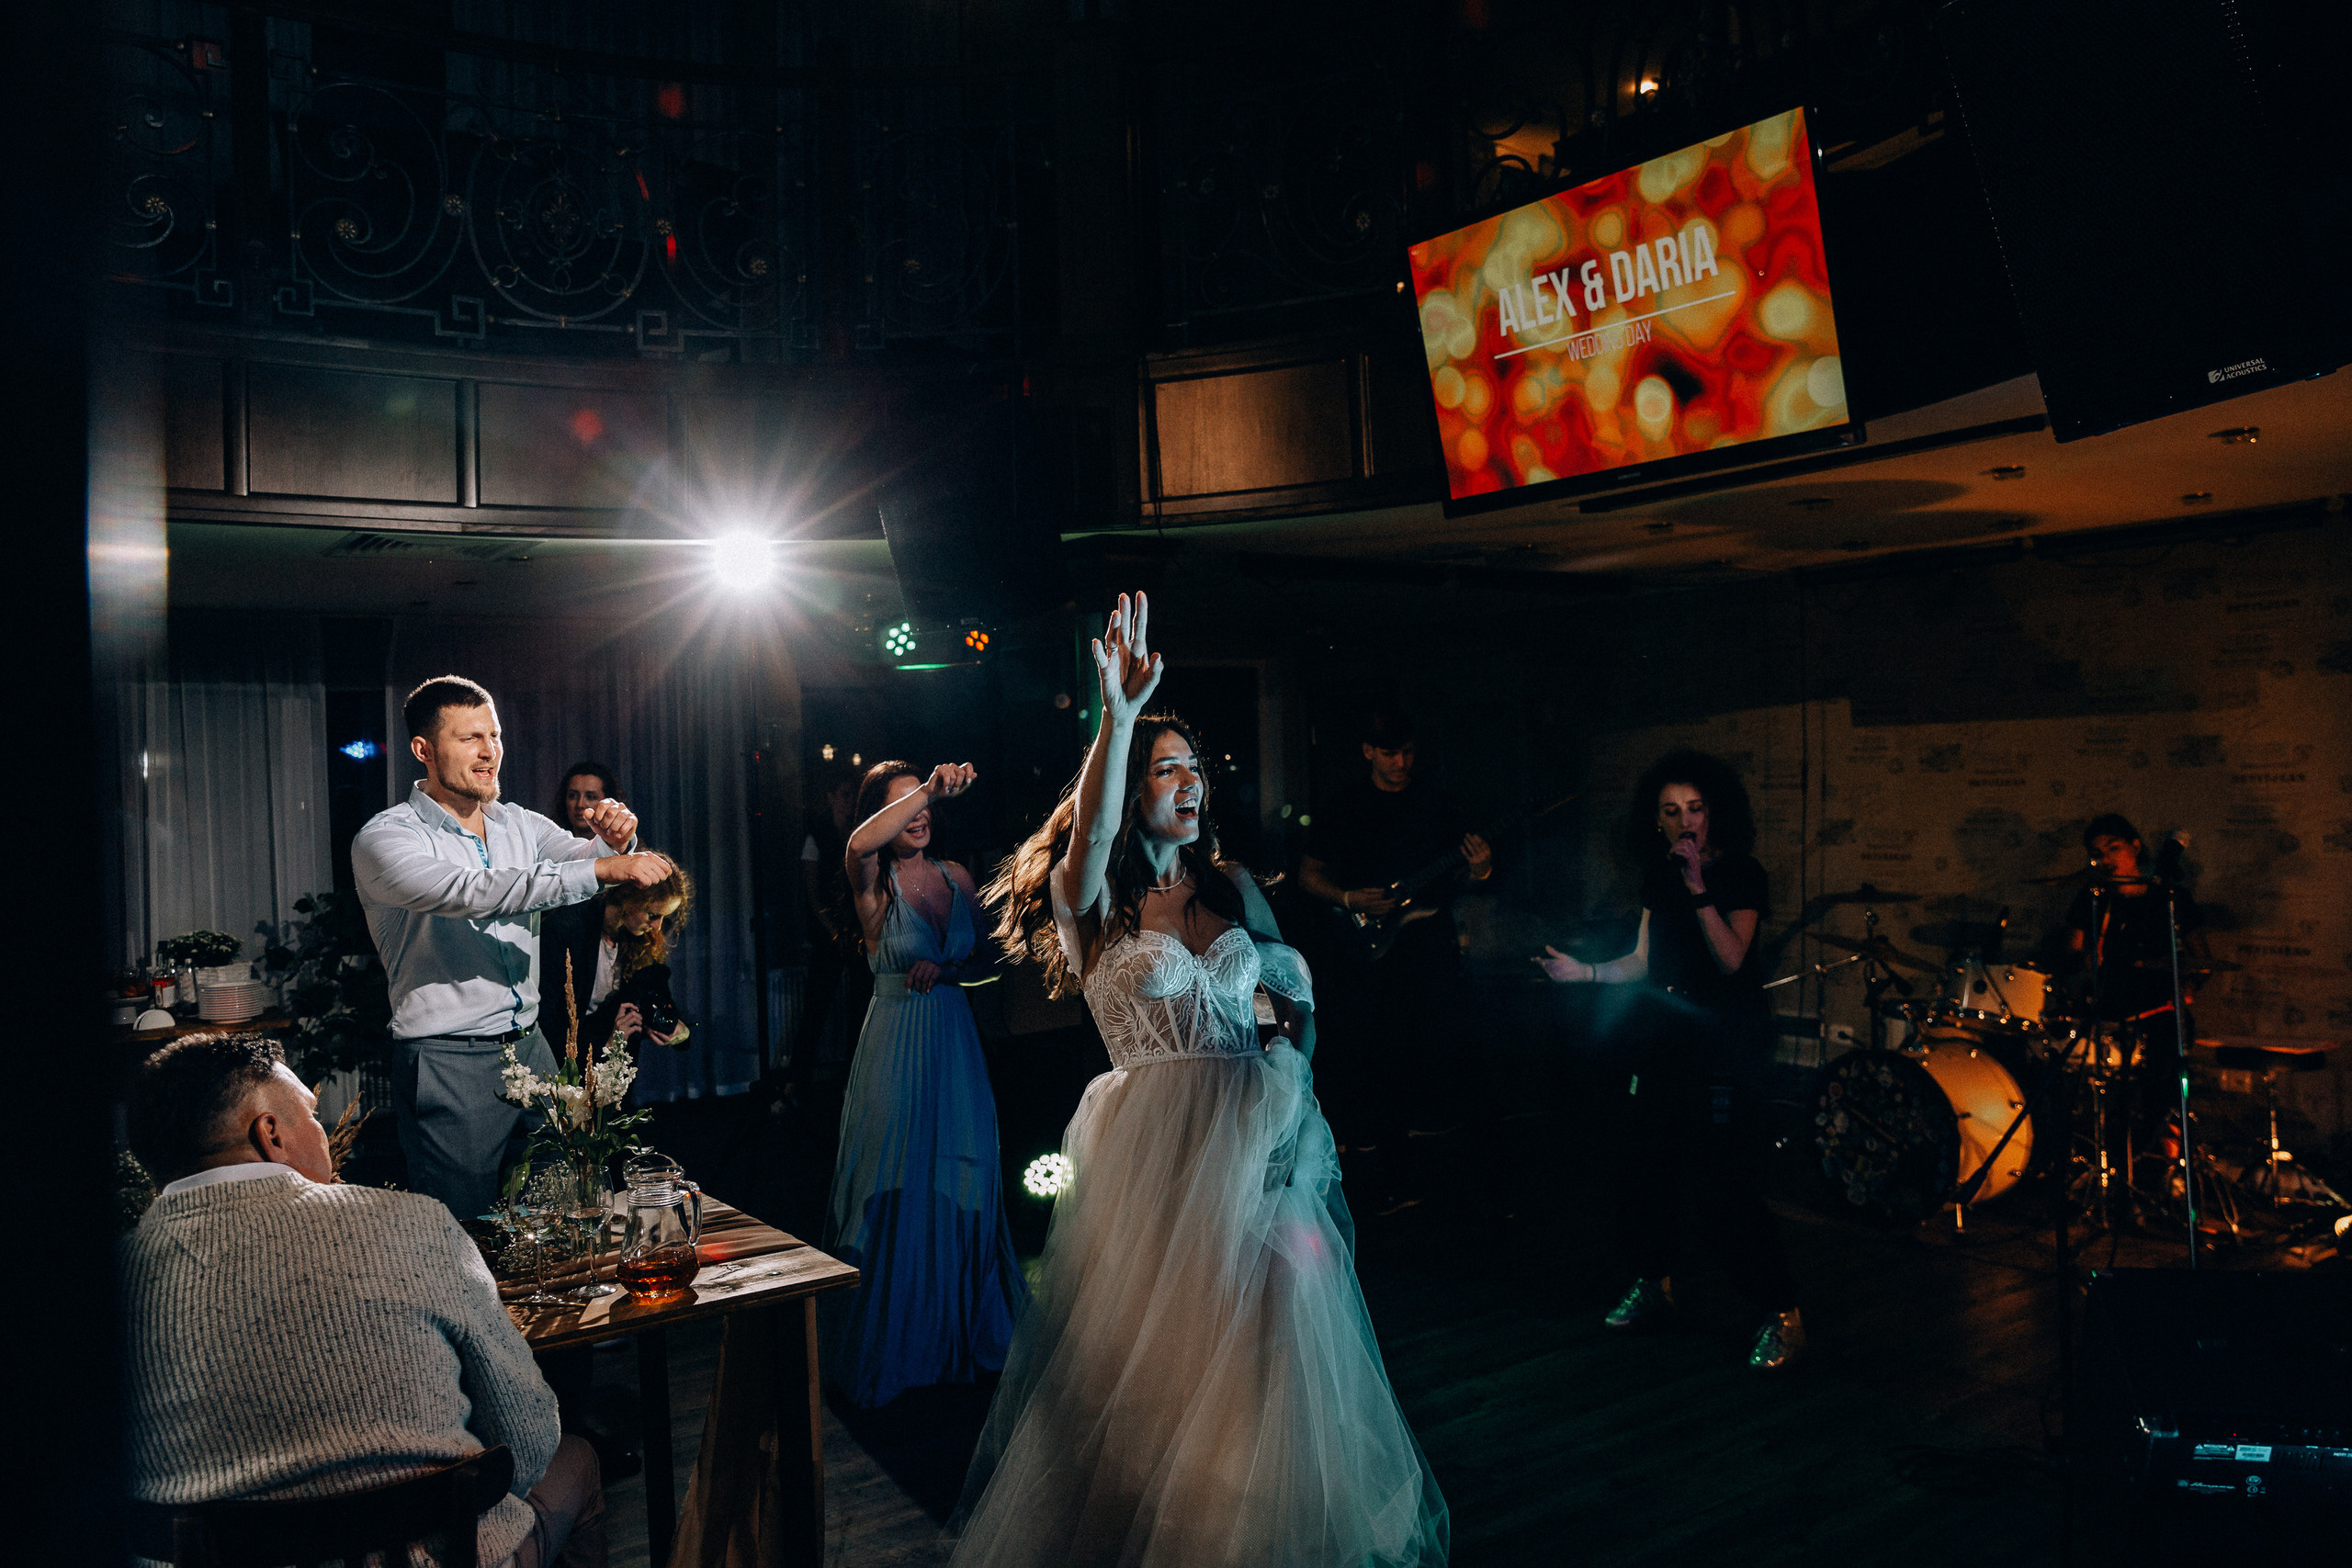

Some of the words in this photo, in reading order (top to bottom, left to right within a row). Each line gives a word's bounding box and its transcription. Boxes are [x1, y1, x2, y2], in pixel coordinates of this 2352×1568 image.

[1498, 268, 1577, 336] ALEX
[1580, 259, 1607, 311] &
[1610, 226, 1719, 303] DARIA
[1566, 329, 1624, 361] WEDDING
[1624, 320, 1652, 347] DAY
[2223, 357, 2265, 373] UNIVERSAL
[2226, 364, 2267, 379] ACOUSTICS
